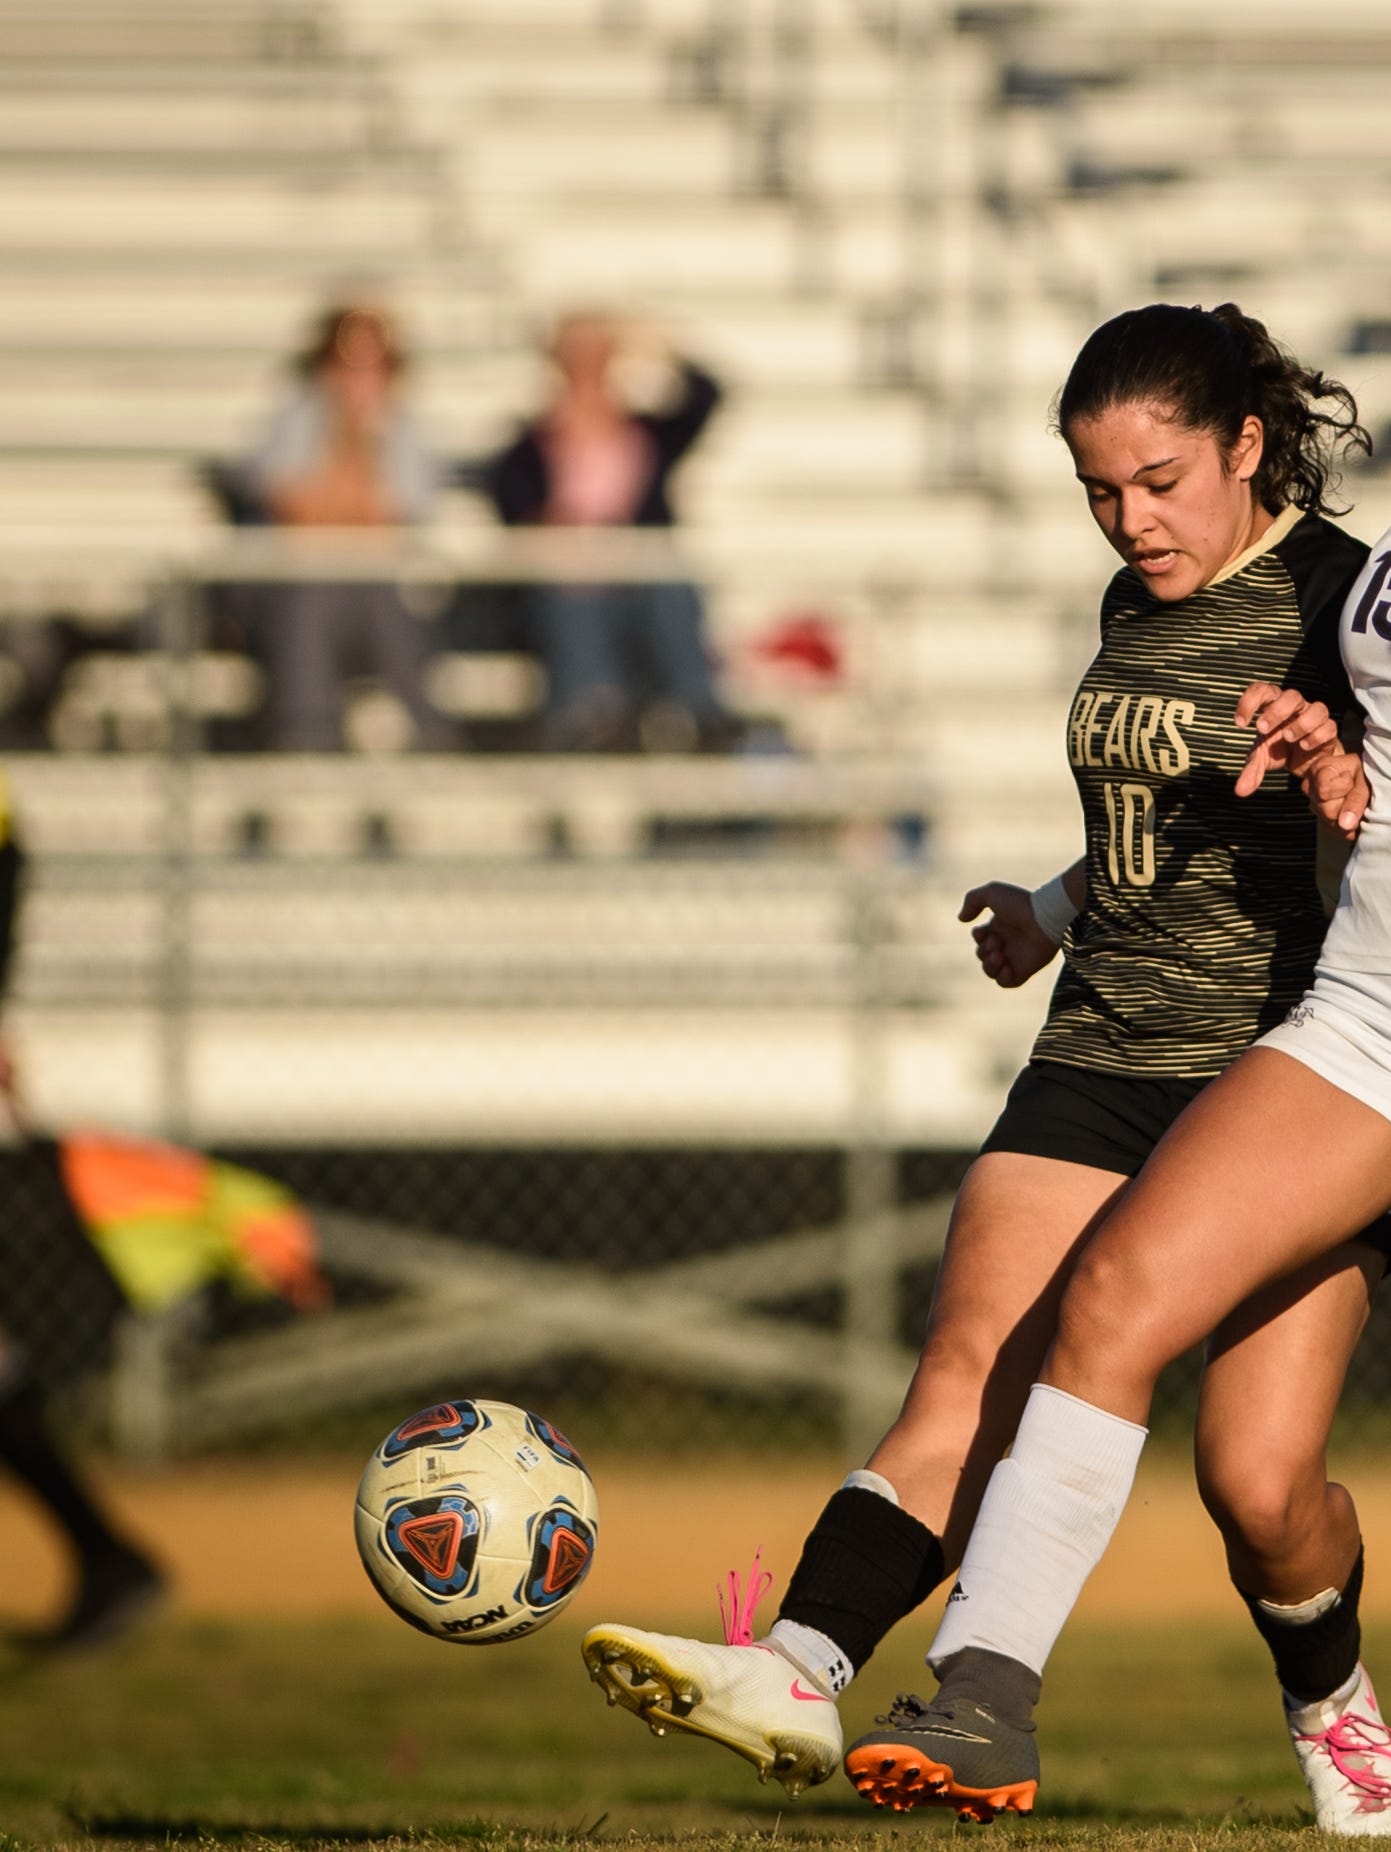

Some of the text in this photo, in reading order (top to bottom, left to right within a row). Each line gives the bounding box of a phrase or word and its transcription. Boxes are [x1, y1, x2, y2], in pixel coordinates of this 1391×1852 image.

[1066, 691, 1196, 777] BEARS
[1104, 782, 1156, 886] 10
[440, 1604, 509, 1632] NCAA
